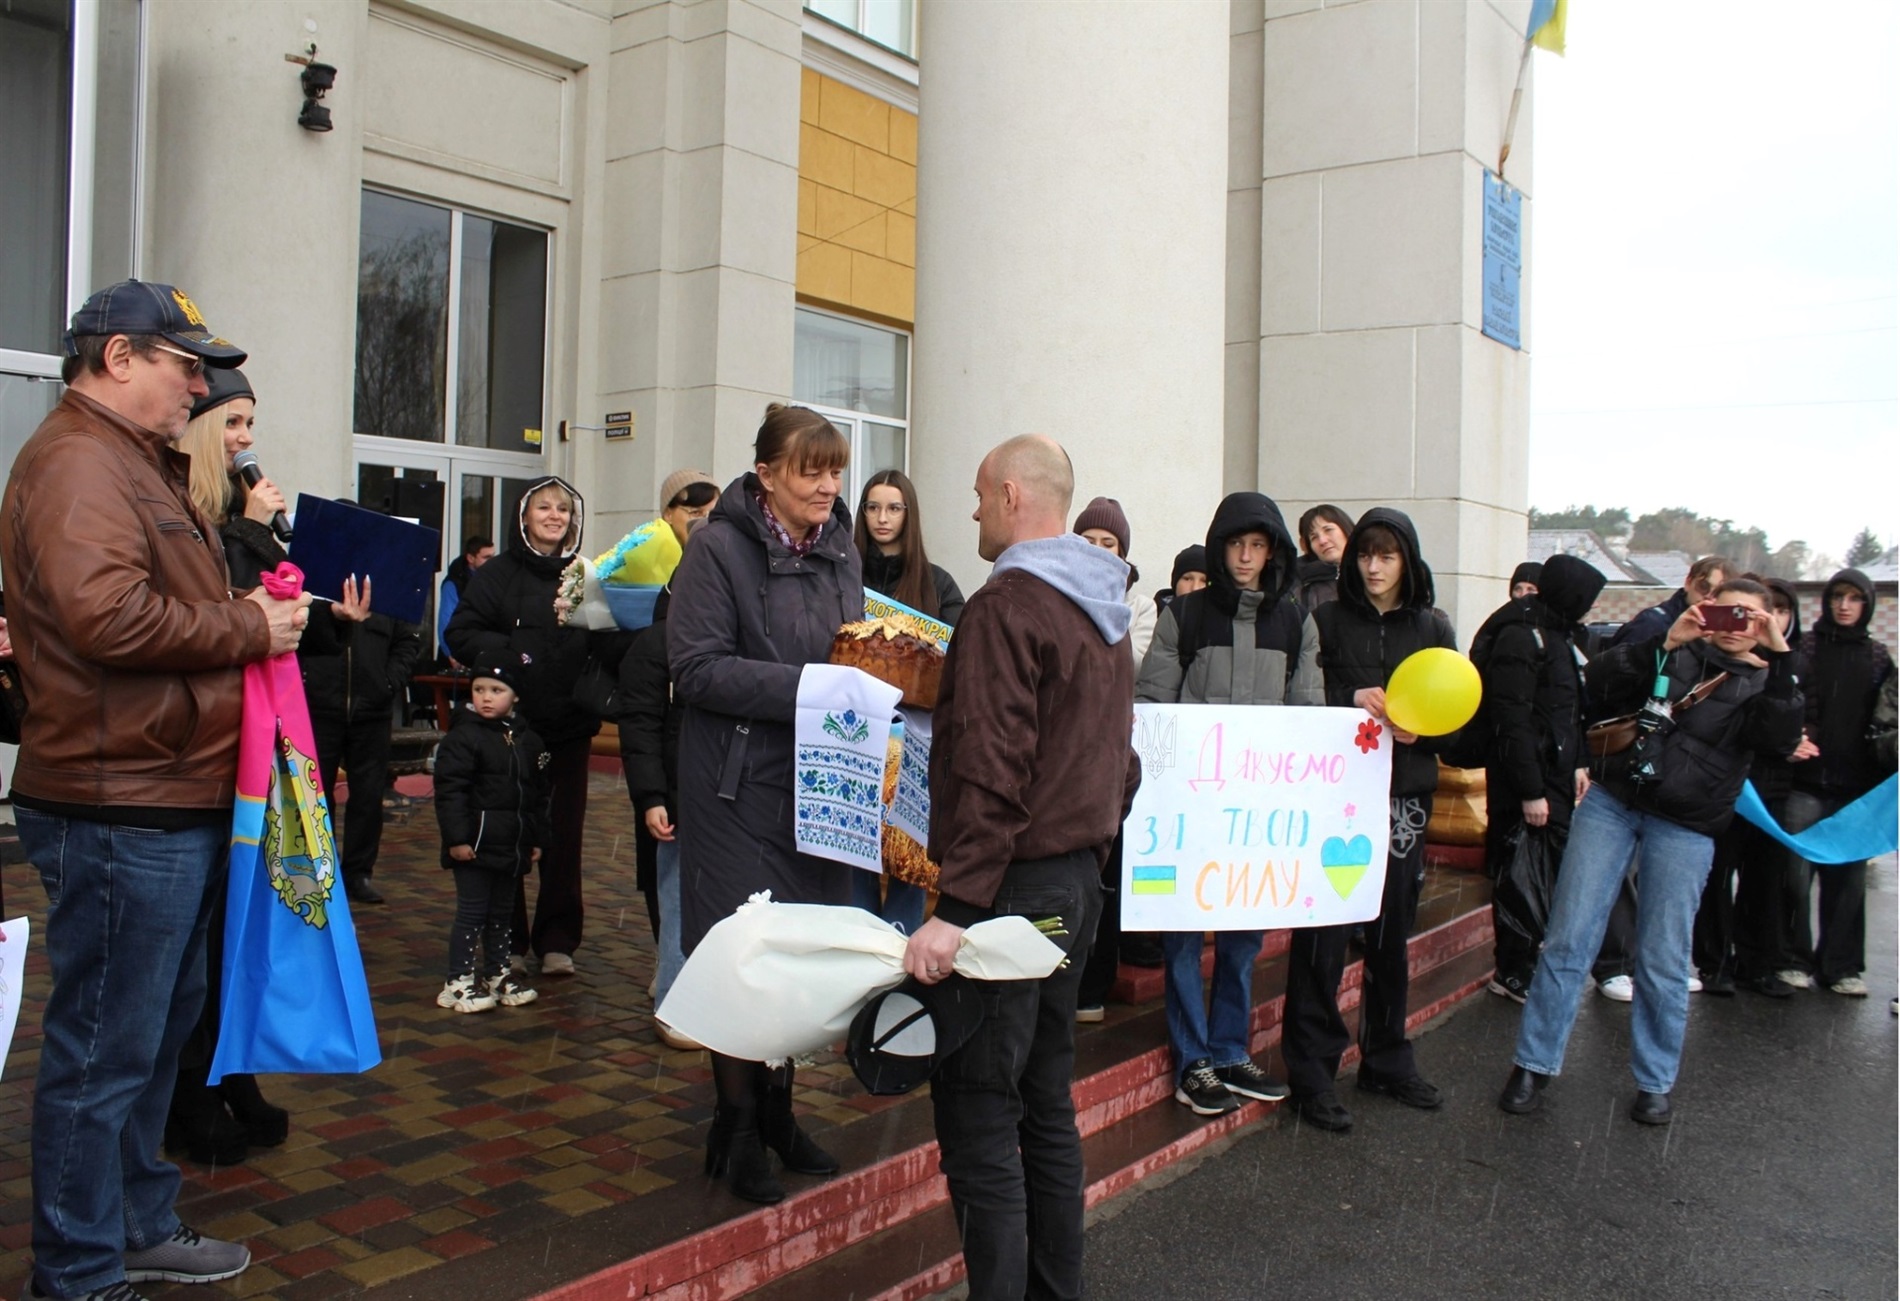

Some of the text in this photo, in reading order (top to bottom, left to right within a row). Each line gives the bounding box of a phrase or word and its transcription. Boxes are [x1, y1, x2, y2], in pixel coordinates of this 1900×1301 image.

[1136, 808, 1309, 855] ЗА ТВОЮ
[1194, 859, 1300, 911] СИЛУ
